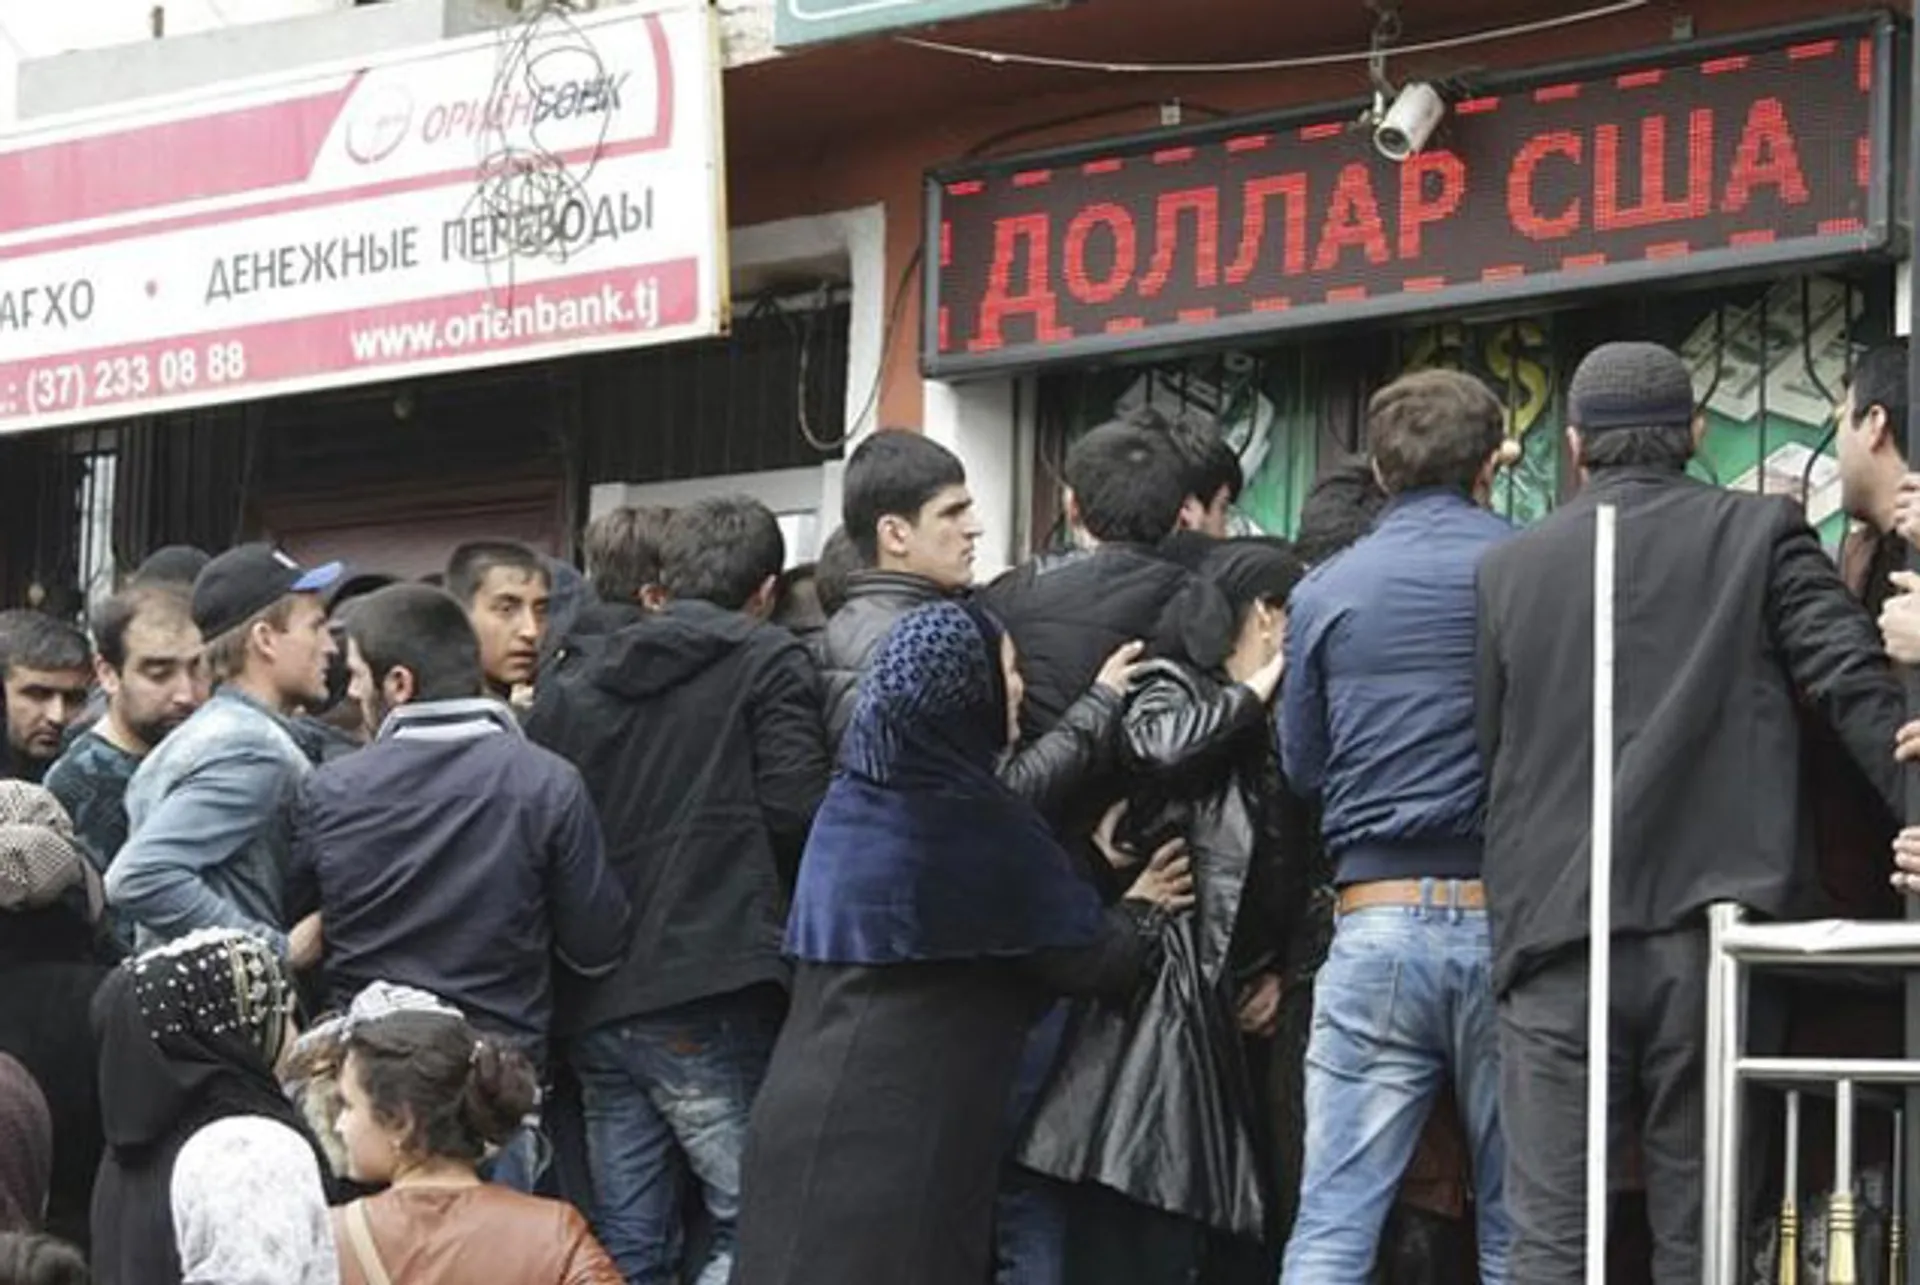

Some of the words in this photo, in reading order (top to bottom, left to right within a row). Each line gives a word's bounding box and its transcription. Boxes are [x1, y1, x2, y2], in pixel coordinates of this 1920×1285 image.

[204, 226, 419, 305] ДЕНЕЖНЫЕ
[441, 187, 654, 262] ПЕРЕВОДЫ
[967, 149, 1466, 353] ДОЛЛАР
[1507, 97, 1809, 241] США
[351, 277, 659, 360] www.orienbank.tj
[27, 363, 85, 415] (37)
[94, 355, 150, 398] 233
[159, 348, 197, 390] 08
[207, 340, 246, 380] 88
